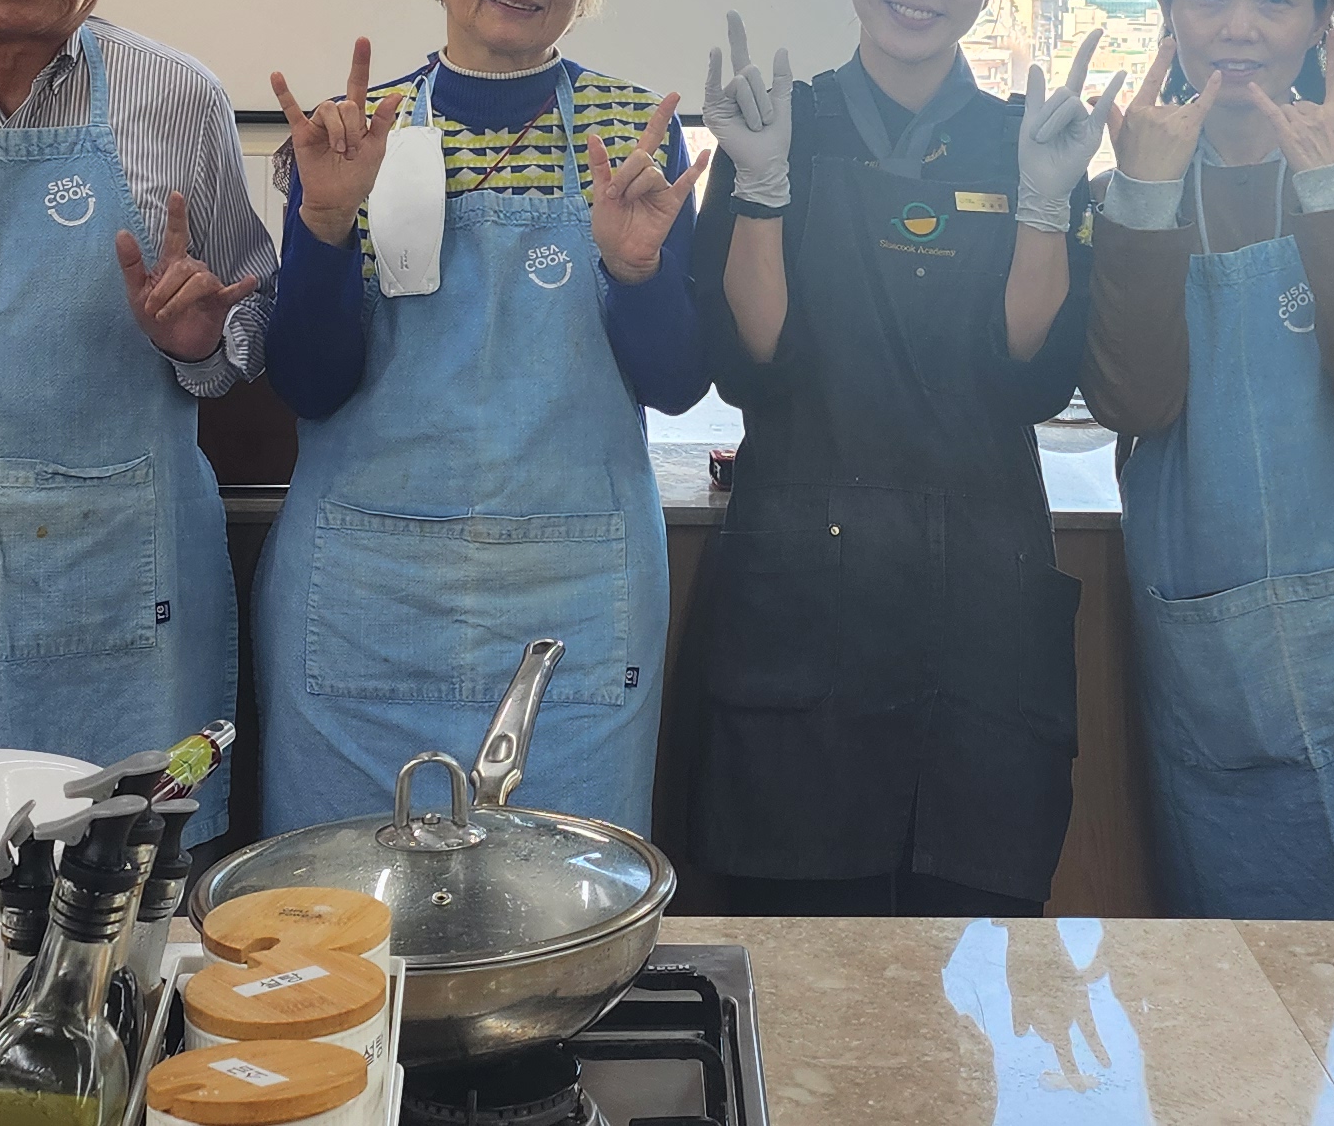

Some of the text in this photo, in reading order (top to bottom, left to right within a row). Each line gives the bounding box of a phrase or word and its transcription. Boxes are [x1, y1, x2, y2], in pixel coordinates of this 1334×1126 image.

[47, 175, 83, 193] SISA
[44, 184, 94, 206] COOK
[528, 244, 560, 259] SISA
[917, 246, 956, 257] Academy
[525, 250, 570, 271] COOK
[1278, 282, 1309, 305] SISA
[259, 972, 304, 989] 설탕
[226, 1064, 269, 1079] 소금
